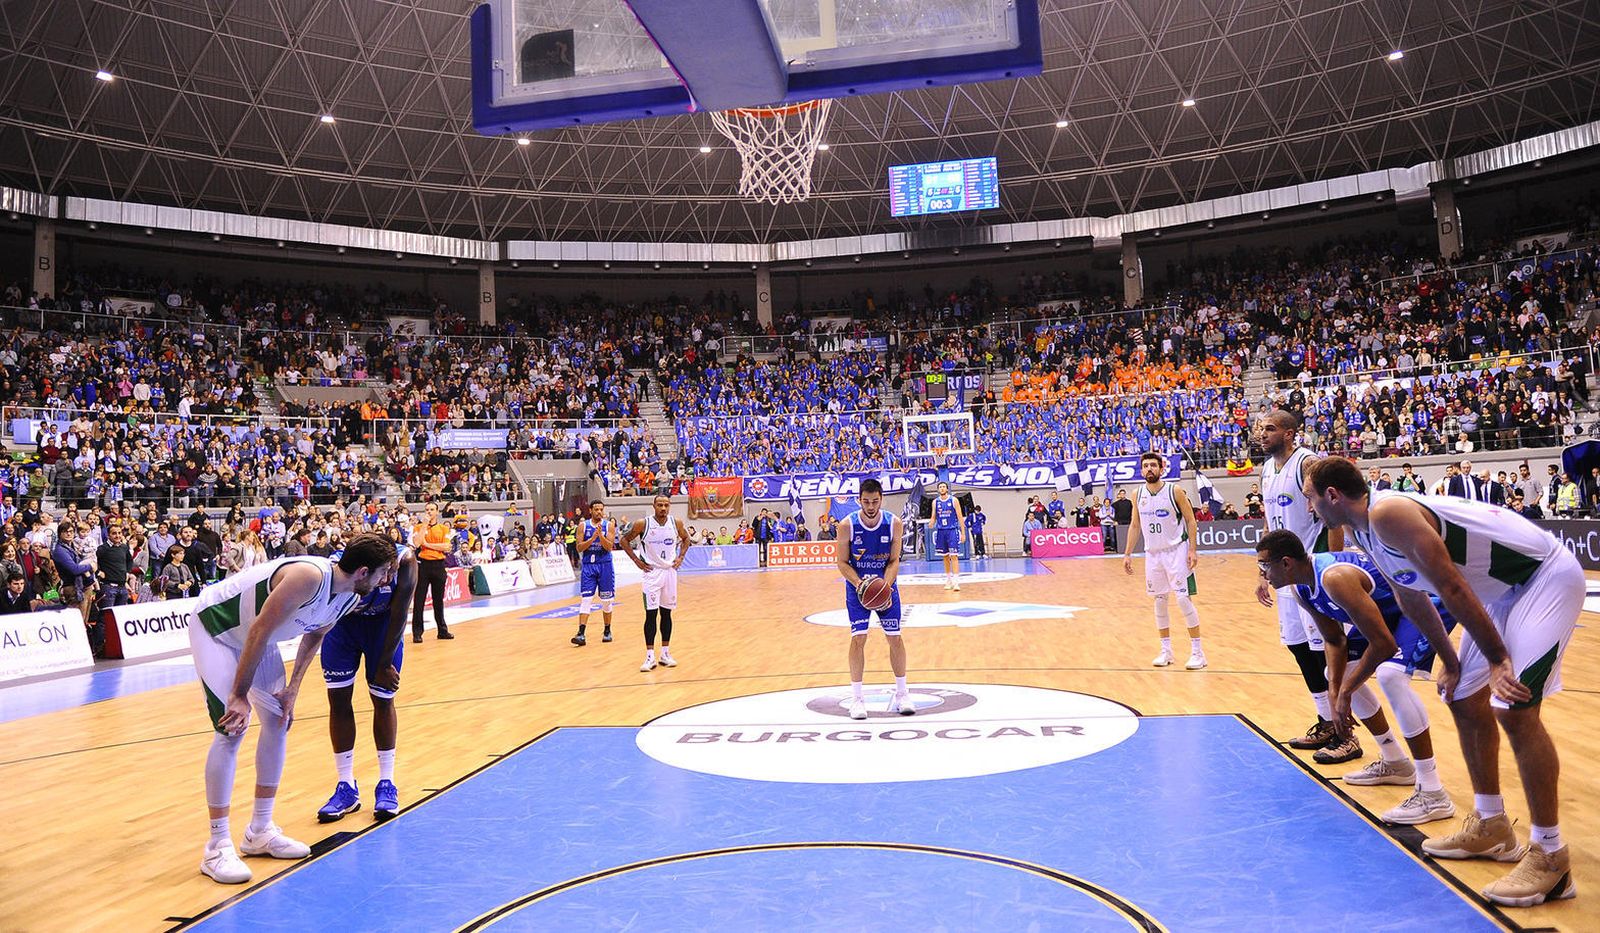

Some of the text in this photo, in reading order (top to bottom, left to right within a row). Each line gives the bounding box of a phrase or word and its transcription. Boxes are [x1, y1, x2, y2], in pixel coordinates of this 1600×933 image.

[930, 199, 953, 210] 00:3
[1441, 222, 1453, 235] D
[39, 256, 50, 270] B
[1126, 267, 1137, 278] C
[482, 291, 492, 303] B
[759, 292, 768, 303] C
[779, 473, 860, 497] PEÑA
[1149, 523, 1162, 534] 30
[1272, 515, 1284, 530] 15
[1034, 530, 1102, 546] endesa
[660, 550, 666, 560] 4
[856, 561, 886, 569] BURGOS
[676, 725, 1086, 744] BURGOCAR
